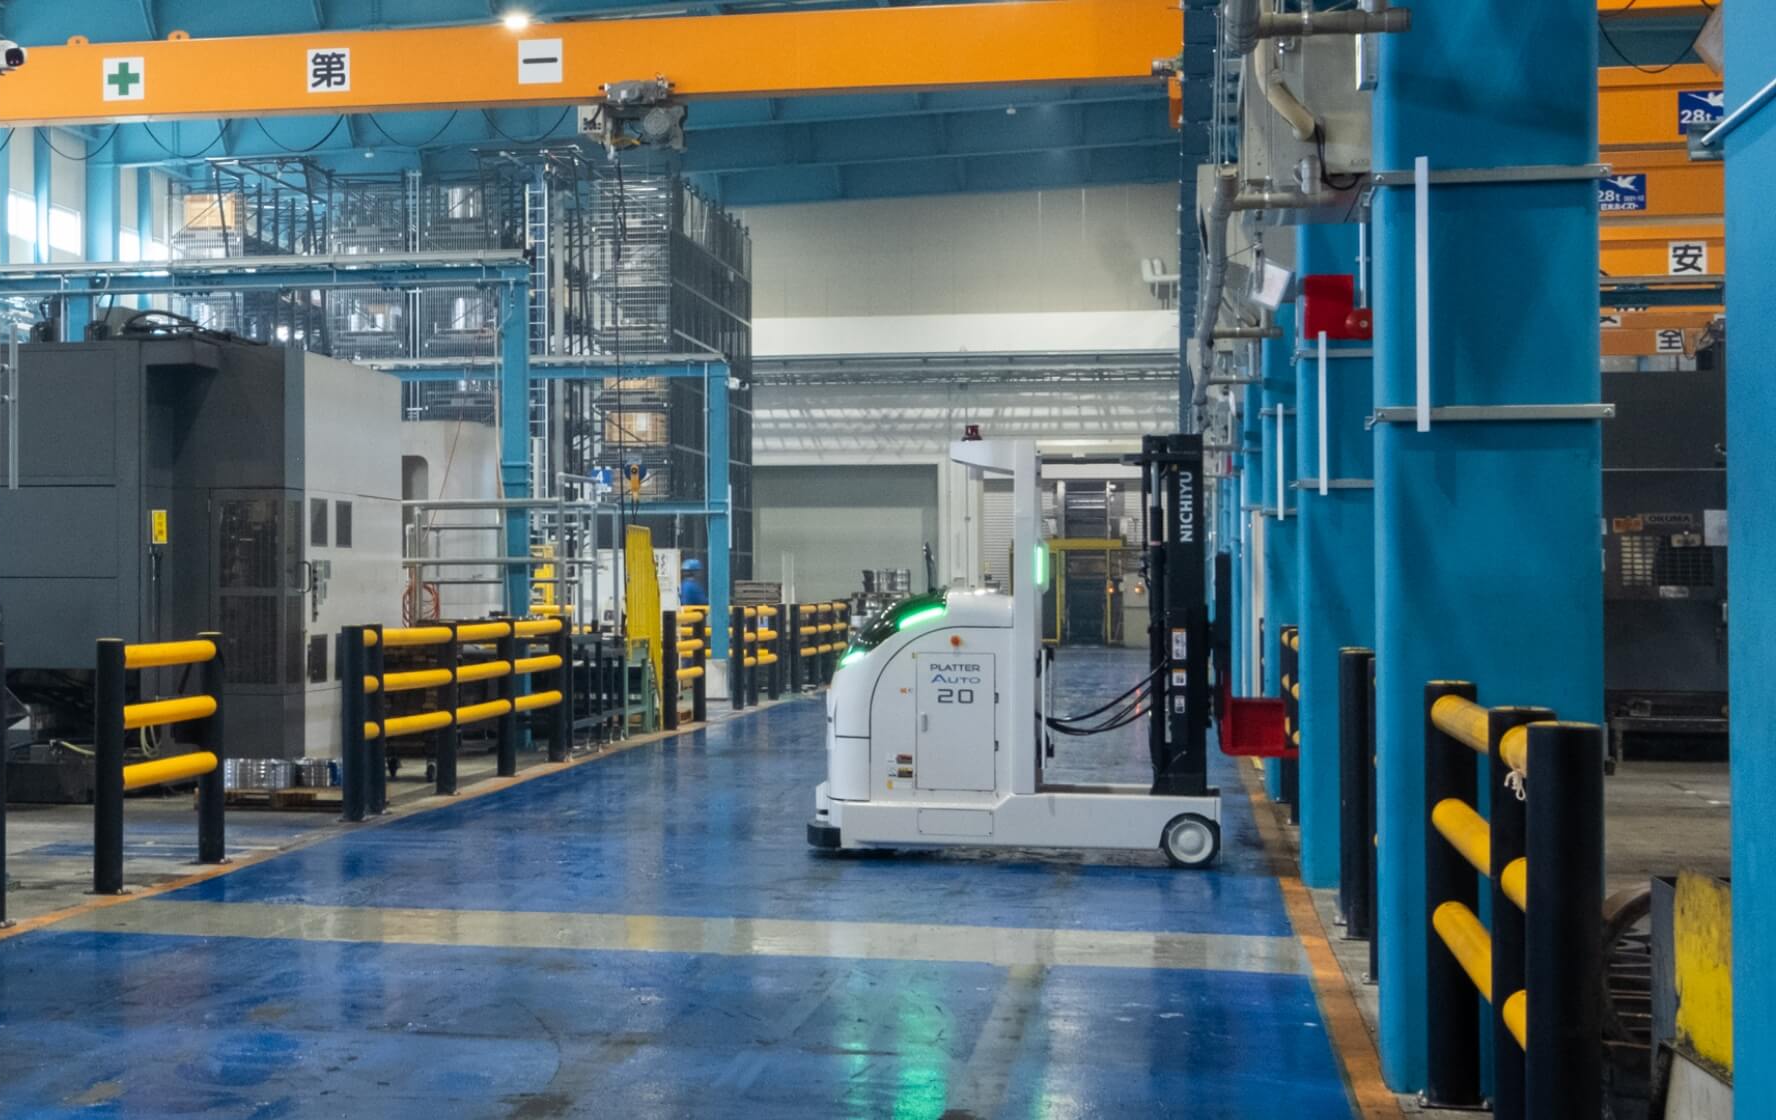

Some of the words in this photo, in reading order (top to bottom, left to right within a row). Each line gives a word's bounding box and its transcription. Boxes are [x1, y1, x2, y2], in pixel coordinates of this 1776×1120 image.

[311, 52, 346, 88] 第
[1672, 244, 1703, 273] 安
[1658, 328, 1682, 350] 全
[1179, 471, 1193, 543] NICHIYU
[930, 663, 981, 673] PLATTER
[937, 688, 974, 705] 20
